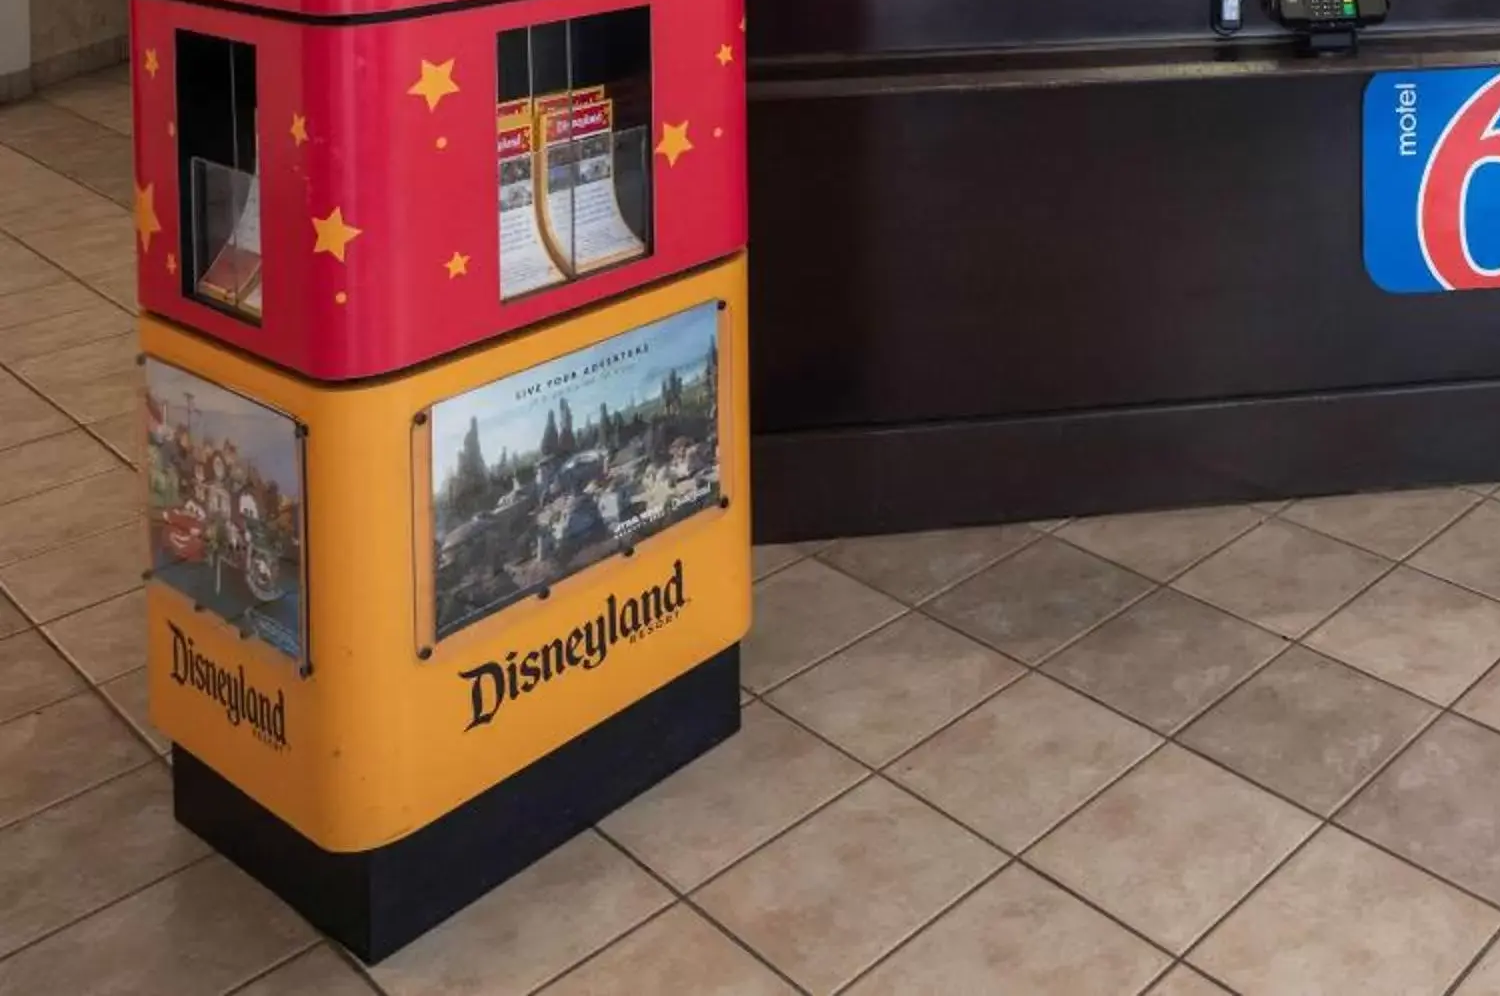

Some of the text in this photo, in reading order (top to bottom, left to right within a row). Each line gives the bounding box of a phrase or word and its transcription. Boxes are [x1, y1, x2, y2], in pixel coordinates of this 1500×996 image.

[1394, 83, 1418, 157] motel
[458, 558, 687, 733] Disneyland
[629, 611, 681, 645] RESORT
[166, 619, 287, 746] Disneyland
